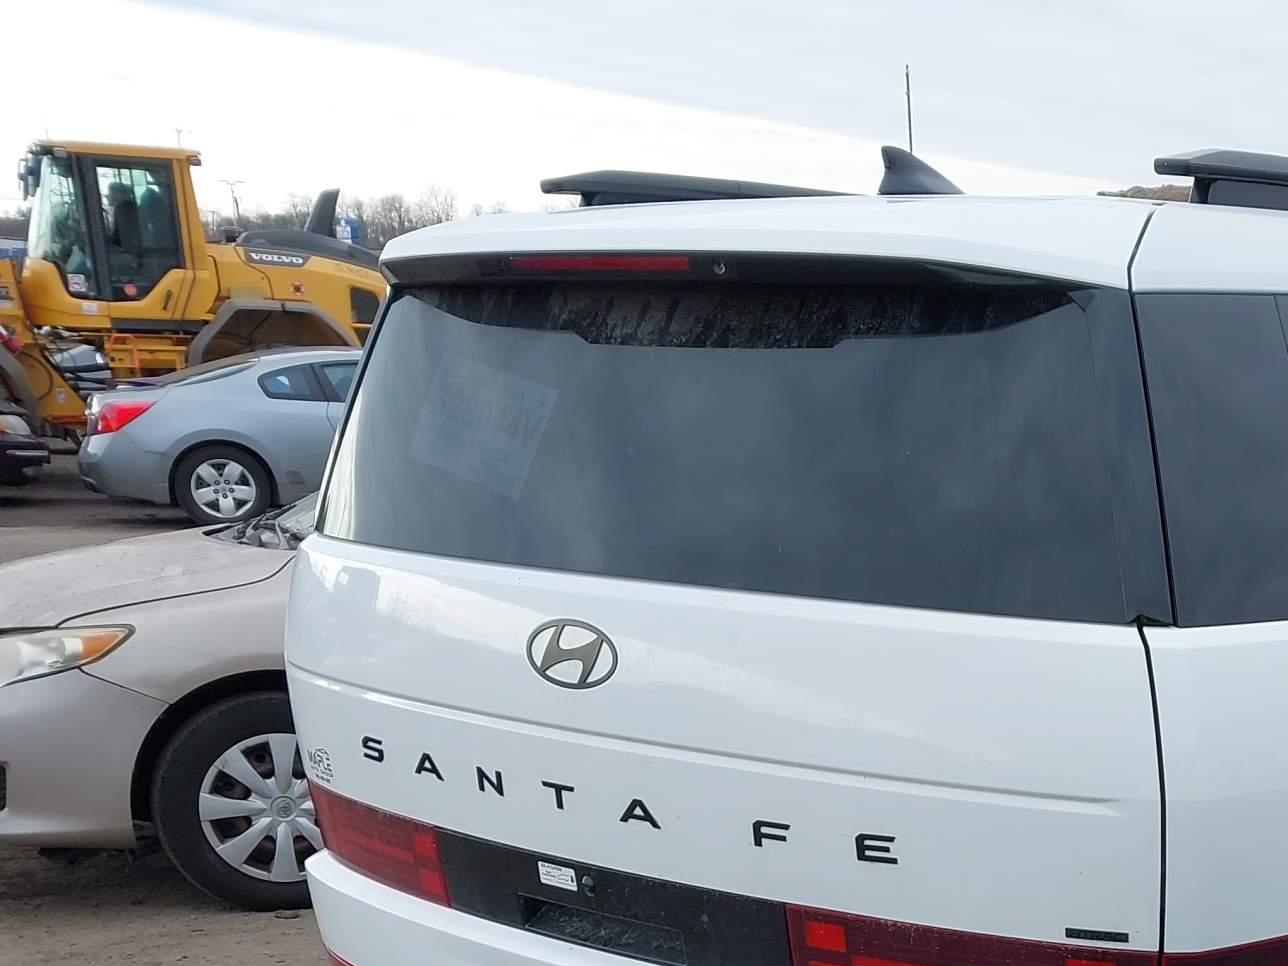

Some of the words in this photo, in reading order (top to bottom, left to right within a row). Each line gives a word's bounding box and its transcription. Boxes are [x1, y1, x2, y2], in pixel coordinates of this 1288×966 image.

[249, 252, 304, 264] VOLVO
[361, 735, 662, 830] SANTA
[751, 819, 899, 865] FE
